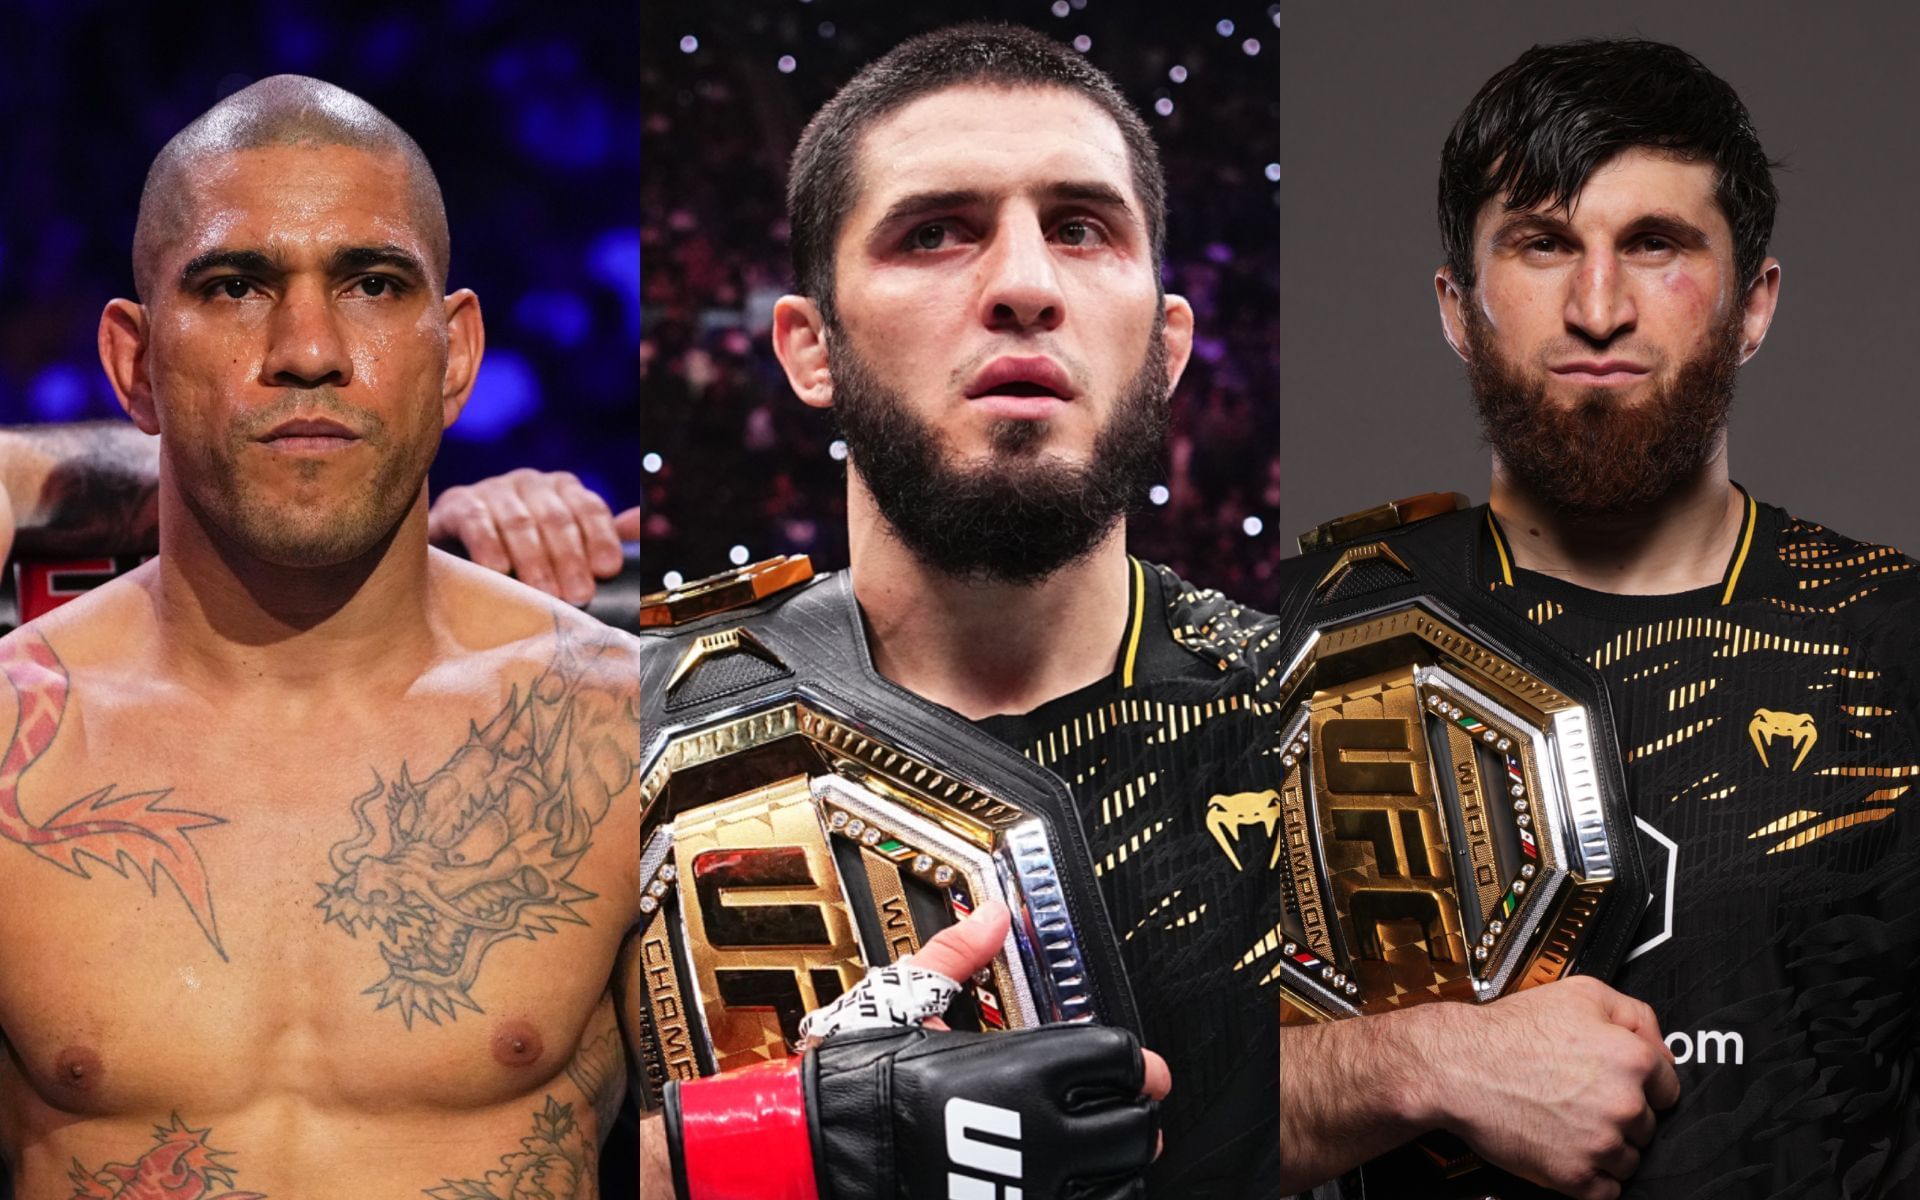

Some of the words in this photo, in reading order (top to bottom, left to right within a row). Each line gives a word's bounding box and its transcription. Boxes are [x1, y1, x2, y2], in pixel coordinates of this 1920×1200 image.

[1284, 786, 1327, 950] CHAMPION
[1320, 718, 1453, 962] UFC
[1458, 761, 1495, 886] WORLD
